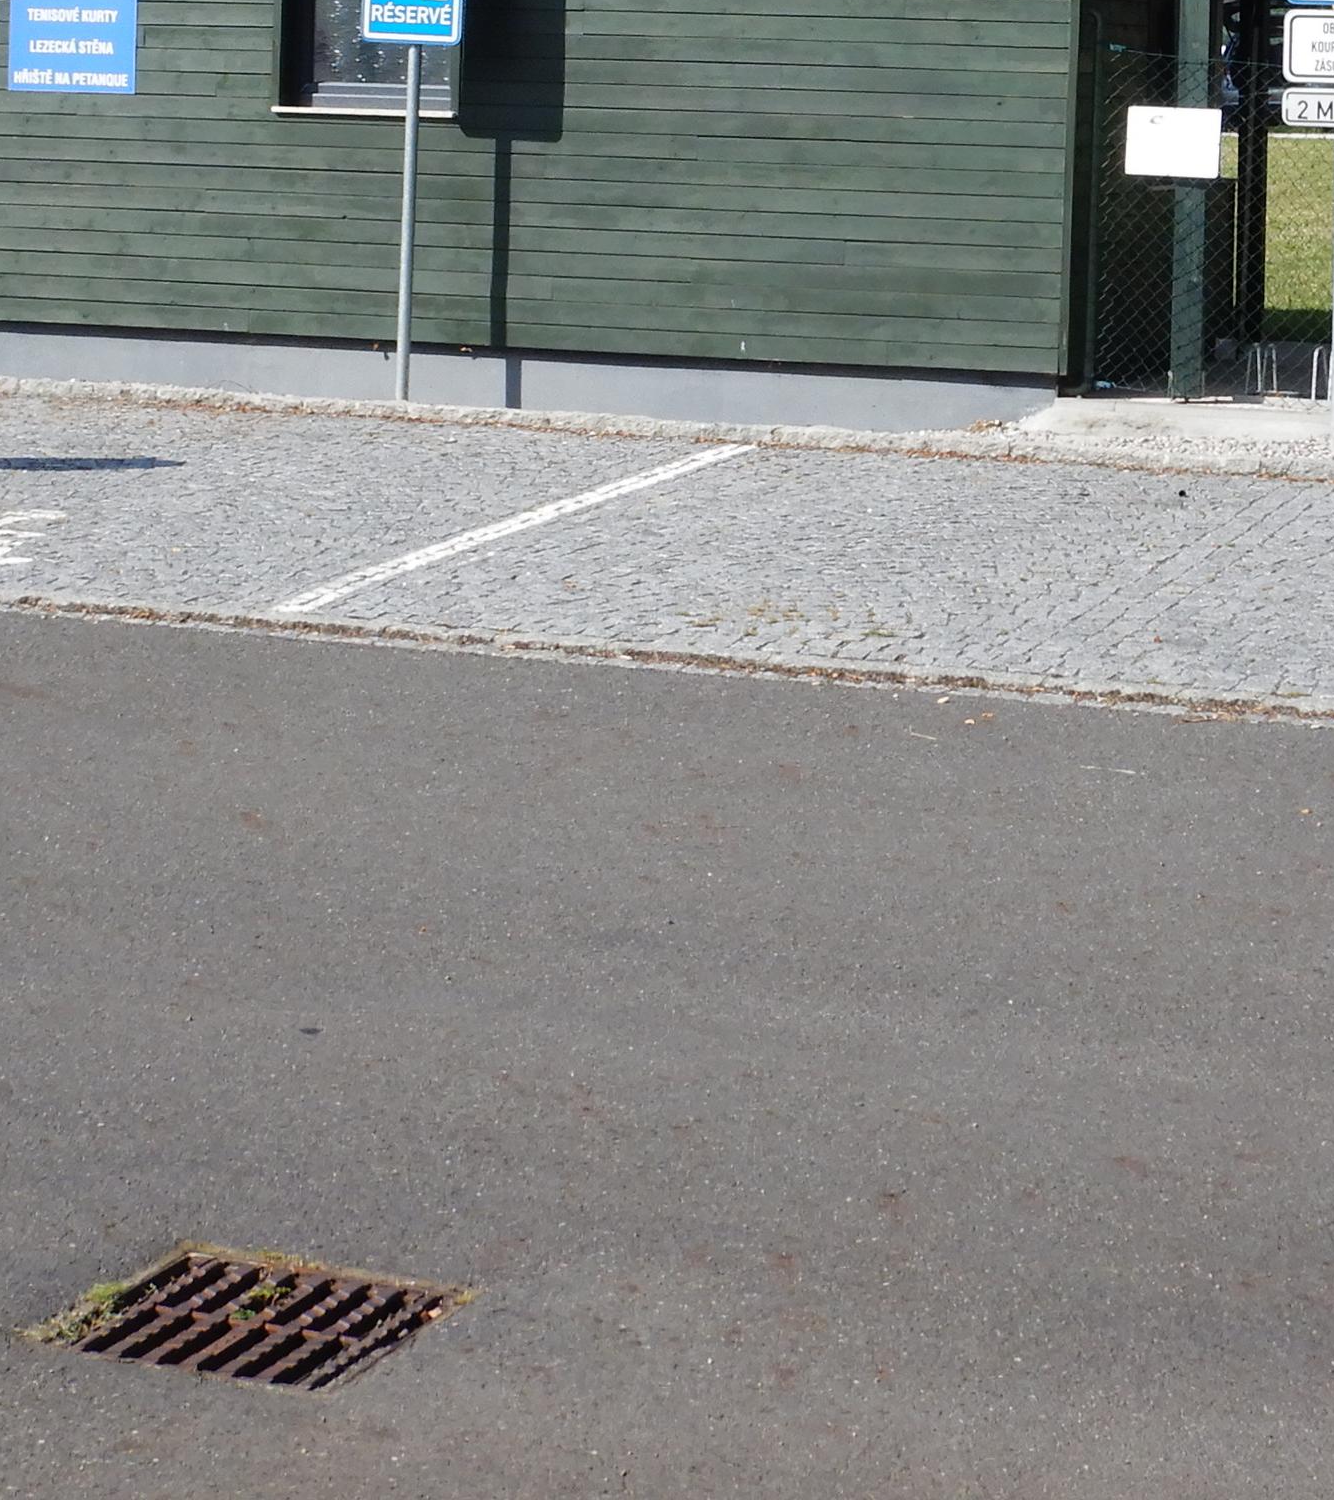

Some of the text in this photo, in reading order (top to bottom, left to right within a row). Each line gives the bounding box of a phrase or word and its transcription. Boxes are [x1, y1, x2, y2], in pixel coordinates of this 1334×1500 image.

[27, 7, 118, 22] TENISOVÉ KURTY
[371, 2, 451, 25] RÉSERVÉ
[29, 38, 114, 54] LEZECKÁ STĚNA
[14, 68, 128, 87] HŘIŠTĚ NA PETANQUE
[1298, 101, 1308, 119] 2
